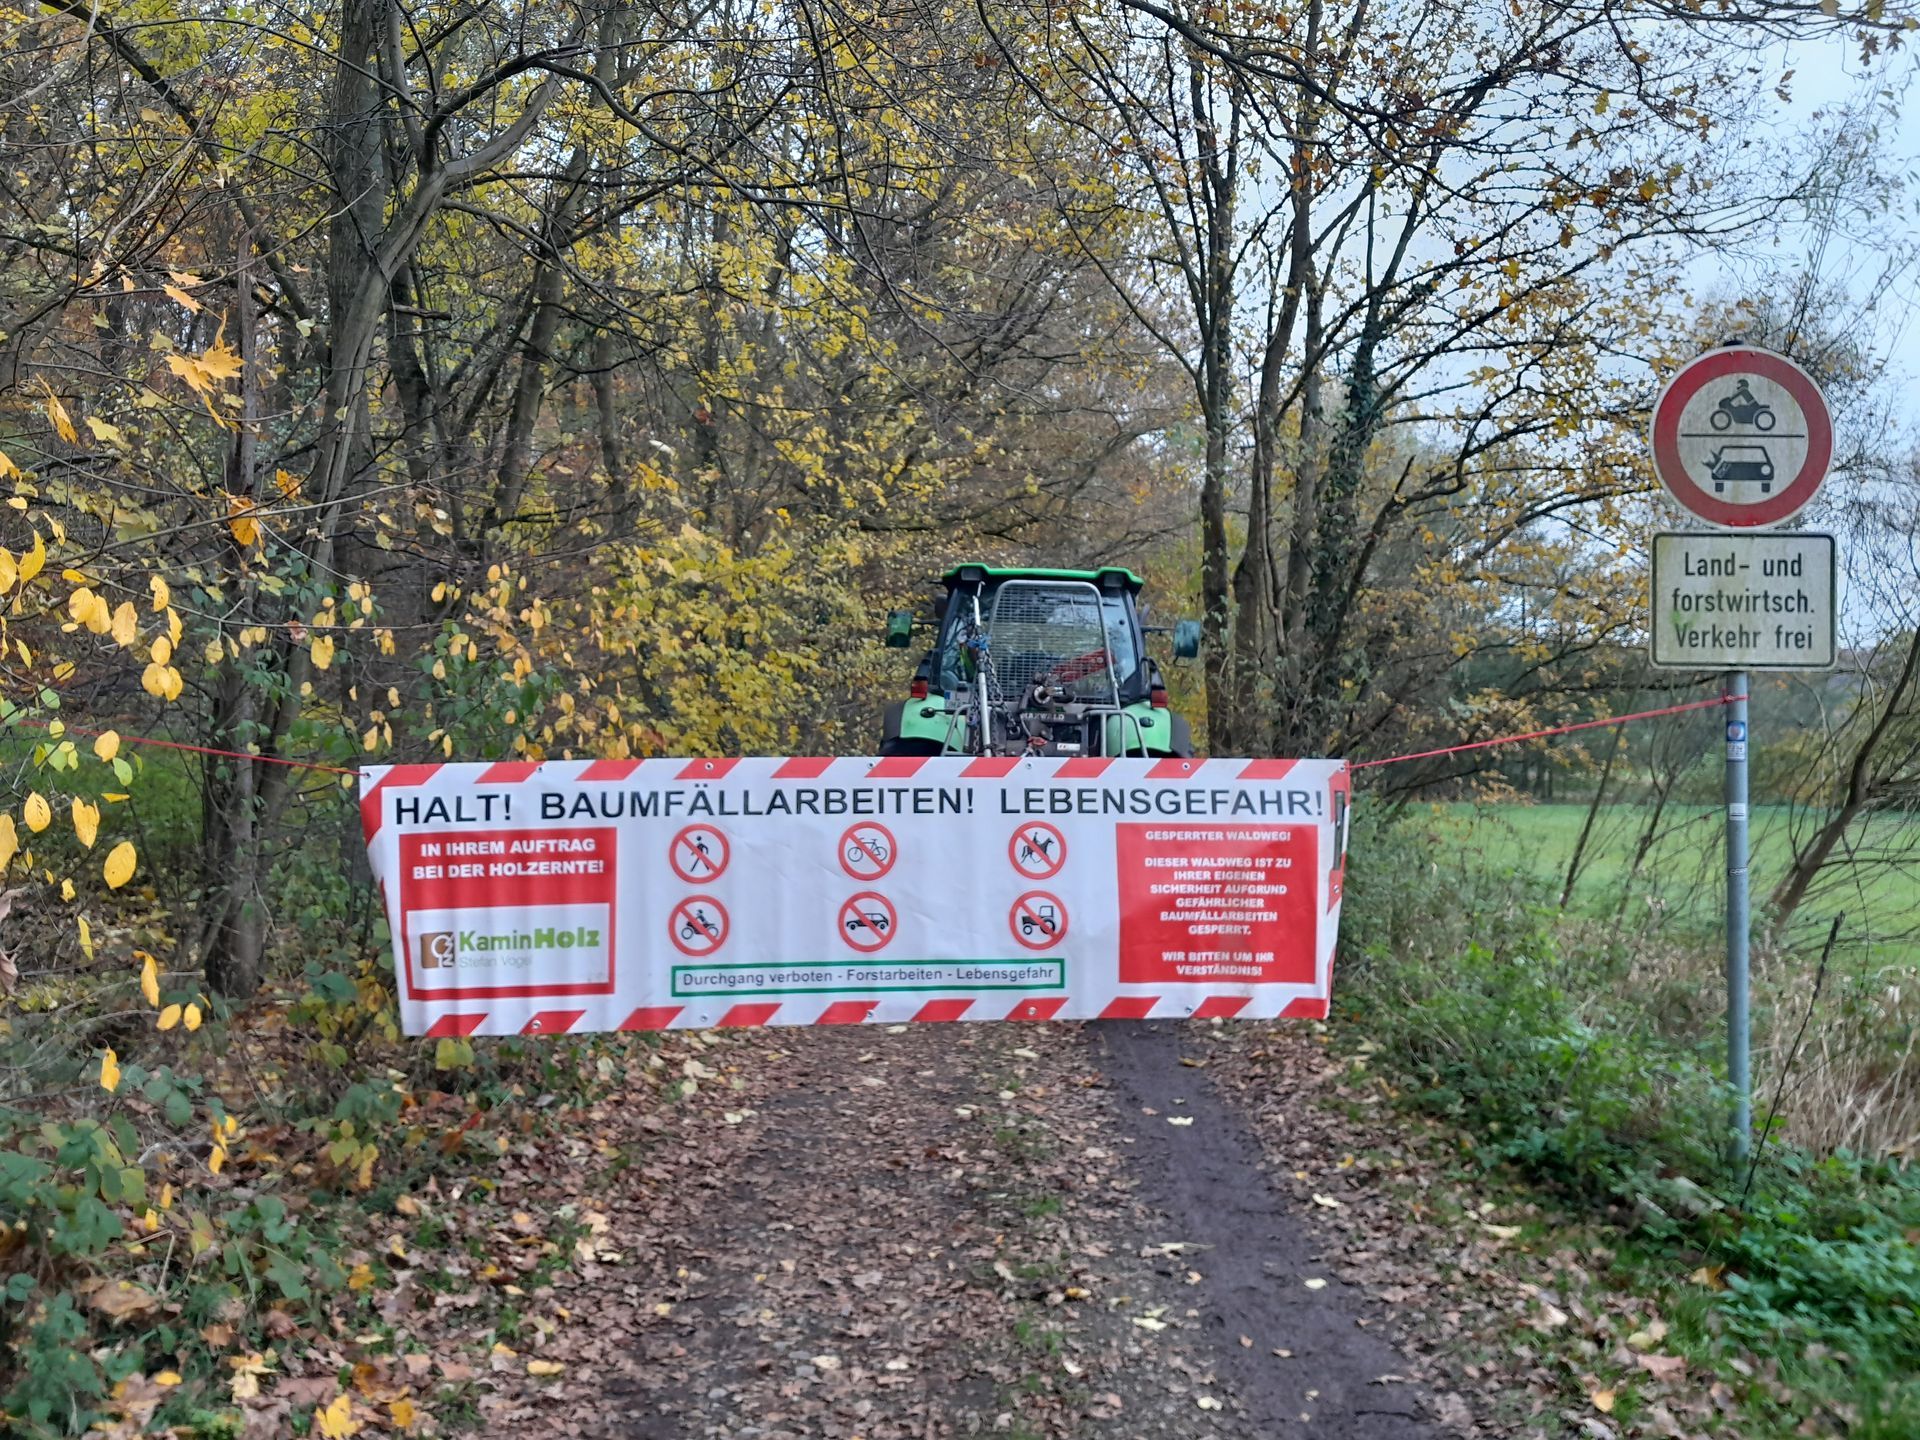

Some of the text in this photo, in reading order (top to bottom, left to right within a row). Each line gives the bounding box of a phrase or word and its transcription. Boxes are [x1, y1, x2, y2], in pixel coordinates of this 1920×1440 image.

[1684, 551, 1802, 577] Land- und
[1672, 588, 1815, 613] forstwirtsch.
[1675, 623, 1812, 649] Verkehr frei
[395, 783, 1323, 825] HALT! BAUMFÄLLARBEITEN! LEBENSGEFAHR!
[1145, 831, 1291, 841] GESPERRTER WALDWEG!
[420, 838, 596, 857] IN IHREM AUFTRAG
[1145, 857, 1292, 868] DIESER WALDWEG IST ZU
[413, 860, 605, 879] BEI DER HOLZERNTE!
[1173, 871, 1265, 881] IHRER EIGENEN
[1150, 884, 1287, 894] SICHERHEIT AUFGRUND
[1176, 896, 1265, 908] GEFÄHRLICHER
[1160, 910, 1277, 922] BAUMFÄLLARBEITEN
[1188, 925, 1252, 935] GESPERRT.
[459, 926, 601, 952] KaminHolz
[459, 955, 497, 969] Stefan
[1162, 952, 1275, 962] WIR BITTEN UM IHR
[1176, 964, 1263, 976] VERSTÄNDNIS!
[683, 972, 765, 987] Durchgang
[769, 970, 833, 982] verboten
[846, 968, 942, 982] Forstarbeiten
[956, 967, 1054, 982] Lebensgefahr
